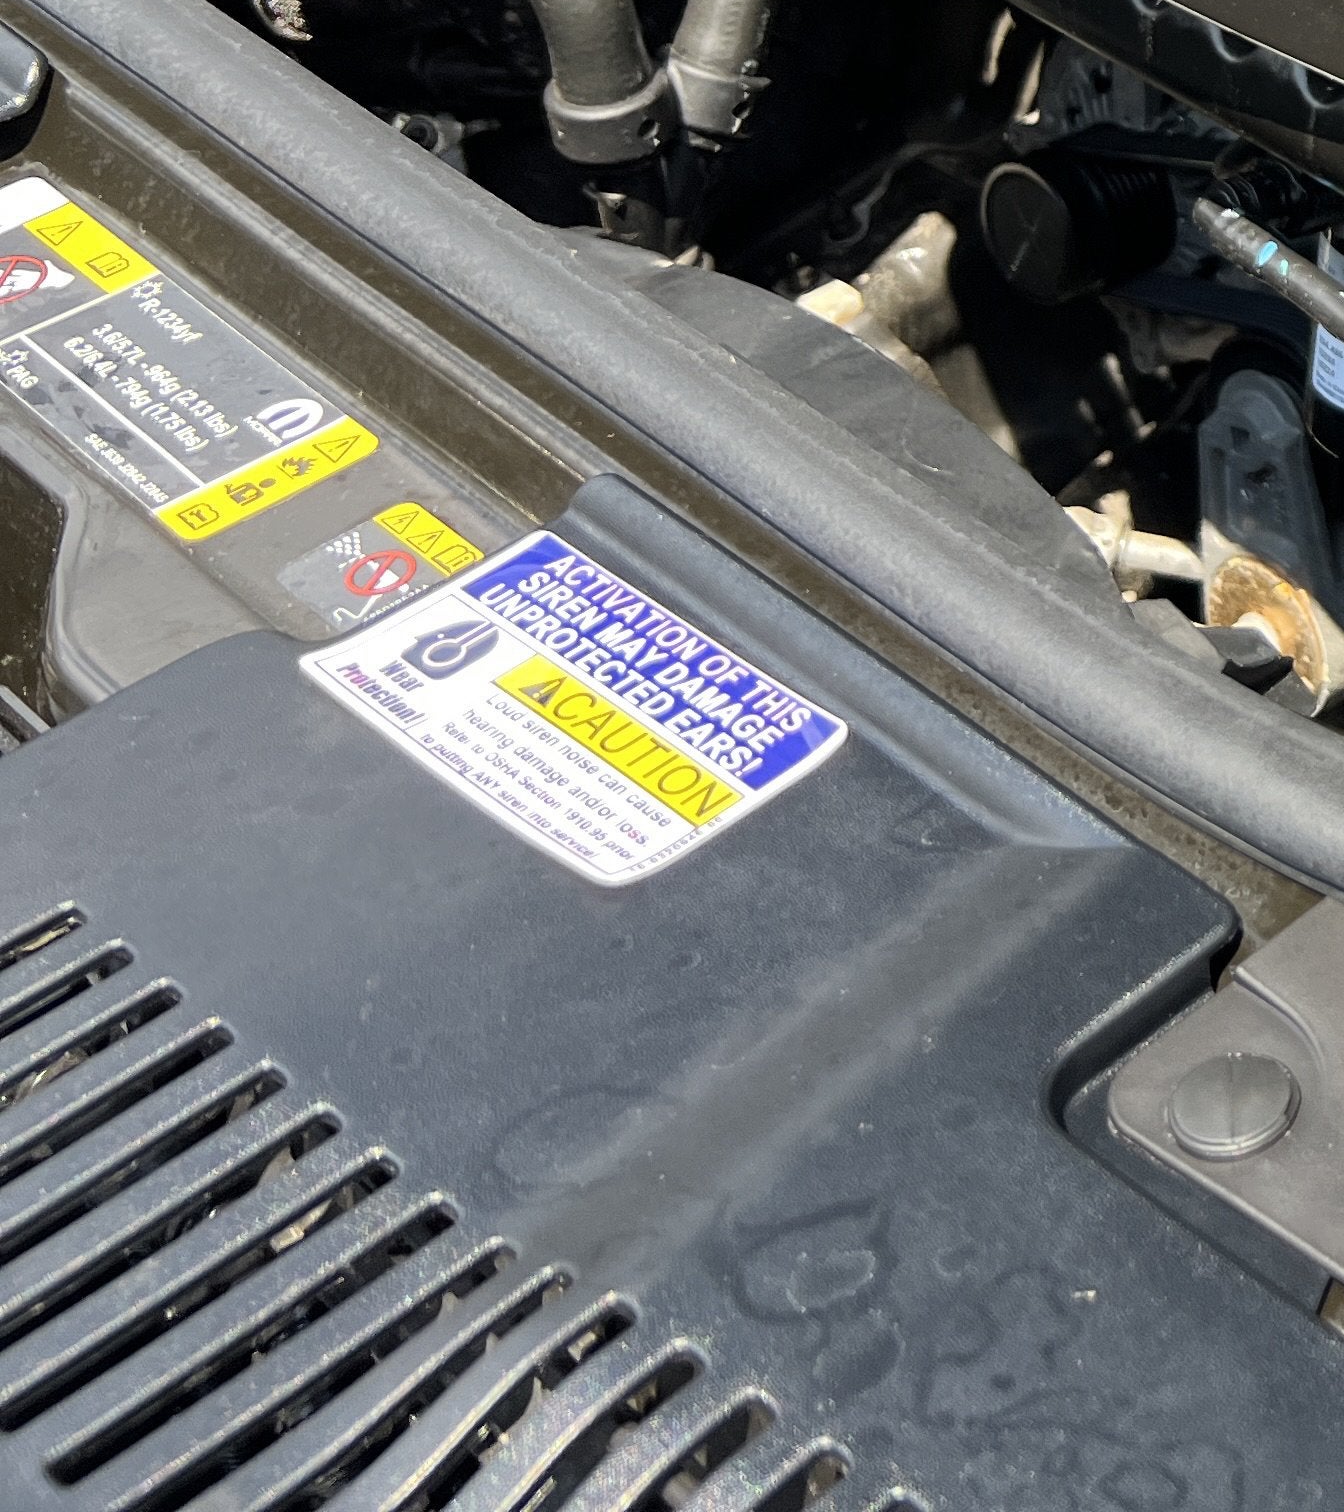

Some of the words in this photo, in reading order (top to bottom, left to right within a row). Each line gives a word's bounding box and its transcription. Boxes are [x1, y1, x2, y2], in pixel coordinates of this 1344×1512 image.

[7, 364, 39, 388] PAG
[92, 323, 146, 365] 3.6/5.7L
[170, 389, 214, 416] (2.13
[203, 412, 239, 438] lbs)
[138, 297, 203, 344] R-1234yf
[141, 402, 186, 431] (1.75
[174, 425, 209, 452] lbs)
[336, 662, 425, 725] Protection!
[379, 659, 424, 692] Wear
[478, 584, 676, 716] UNPROTECTED
[664, 711, 764, 778] EARS!
[518, 571, 607, 635] SIREN
[593, 622, 669, 670] MAY
[653, 661, 785, 753] DAMAGE
[543, 555, 711, 661] ACTIVATION
[697, 655, 750, 687] OF
[742, 679, 812, 733] THIS
[420, 733, 435, 745] to
[428, 743, 474, 776] putting
[471, 770, 501, 790] ANY
[497, 790, 529, 813] siren
[527, 810, 552, 830] into
[442, 722, 472, 745] Refer
[471, 743, 485, 755] to
[484, 751, 521, 780] OSHA
[517, 777, 562, 810] Section
[562, 805, 608, 842] 1910.95
[602, 837, 636, 861] prior
[462, 708, 515, 750] hearing
[512, 743, 571, 788] damage
[567, 784, 619, 822] and/or
[617, 818, 649, 848] loss.
[485, 693, 528, 722] Loud
[522, 721, 561, 748] siren
[557, 744, 601, 775] noise
[597, 773, 628, 796] can
[625, 792, 673, 828] cause
[552, 691, 734, 818] CAUTION
